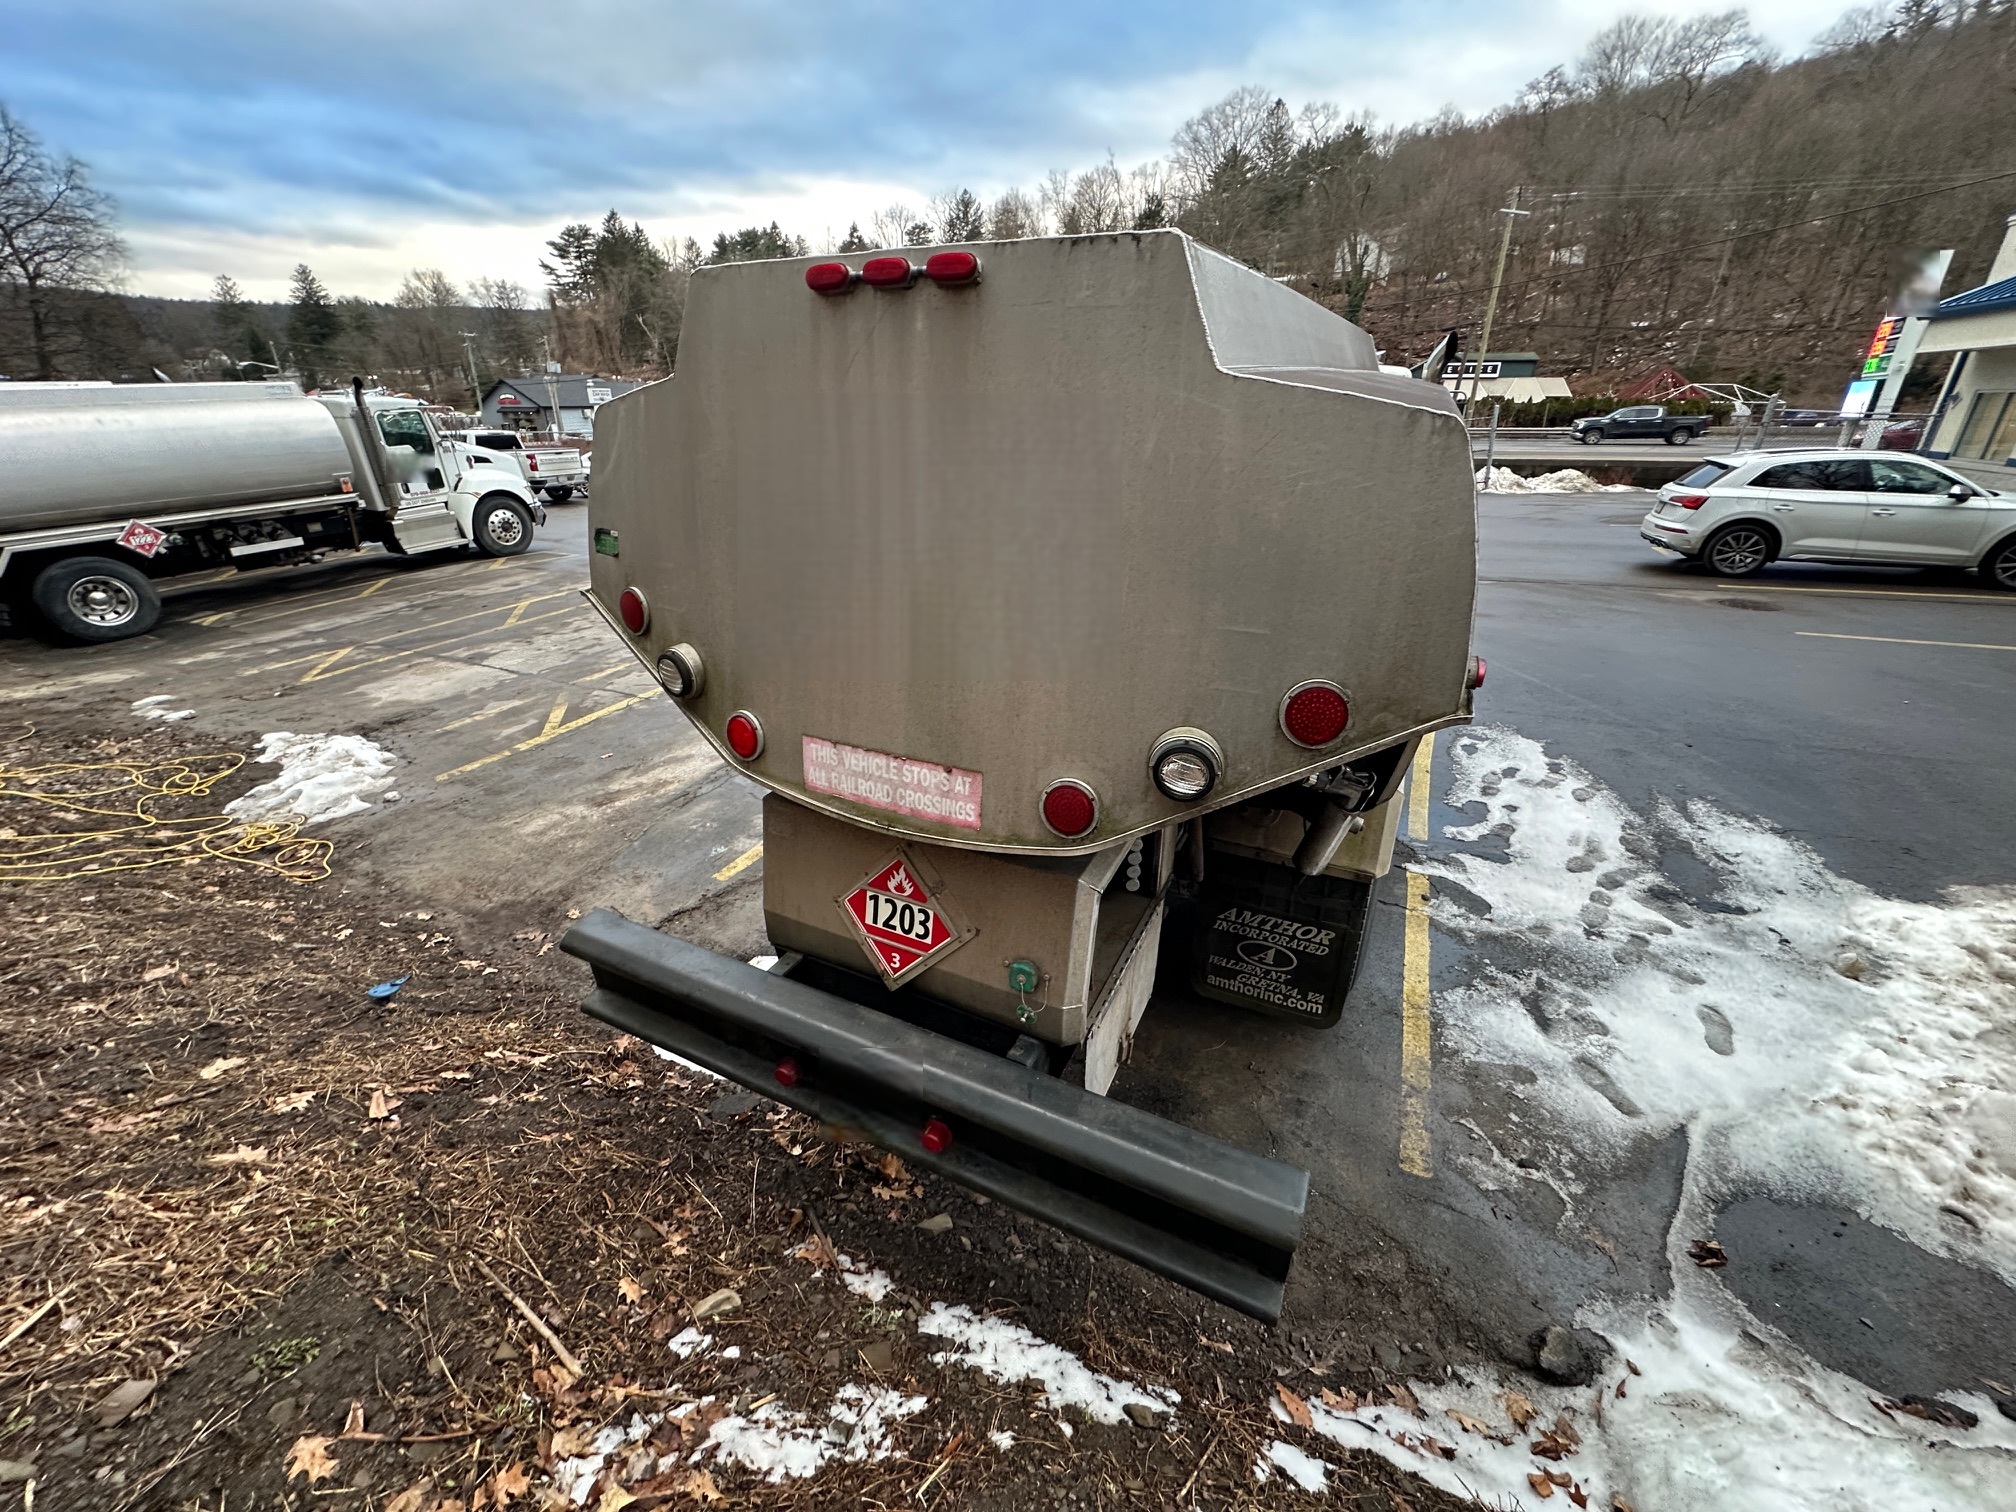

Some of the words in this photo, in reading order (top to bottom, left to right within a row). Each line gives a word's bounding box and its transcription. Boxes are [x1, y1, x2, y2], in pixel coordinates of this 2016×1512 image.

[810, 743, 839, 766] THIS
[842, 750, 899, 779] VEHICLE
[902, 764, 950, 792] STOPS
[954, 777, 972, 796] AT
[808, 766, 829, 788] ALL
[831, 772, 892, 802] RAILROAD
[896, 788, 975, 822] CROSSINGS
[868, 894, 931, 940] 1203
[1217, 907, 1336, 945] AMTHOR
[1213, 920, 1330, 956] INCORPORATED
[1250, 947, 1277, 965] A
[890, 952, 901, 968] 3
[1208, 955, 1266, 979] WALDEN,
[1266, 971, 1292, 983] NY
[1237, 973, 1303, 999] GRETNA,
[1306, 992, 1326, 1004] VA
